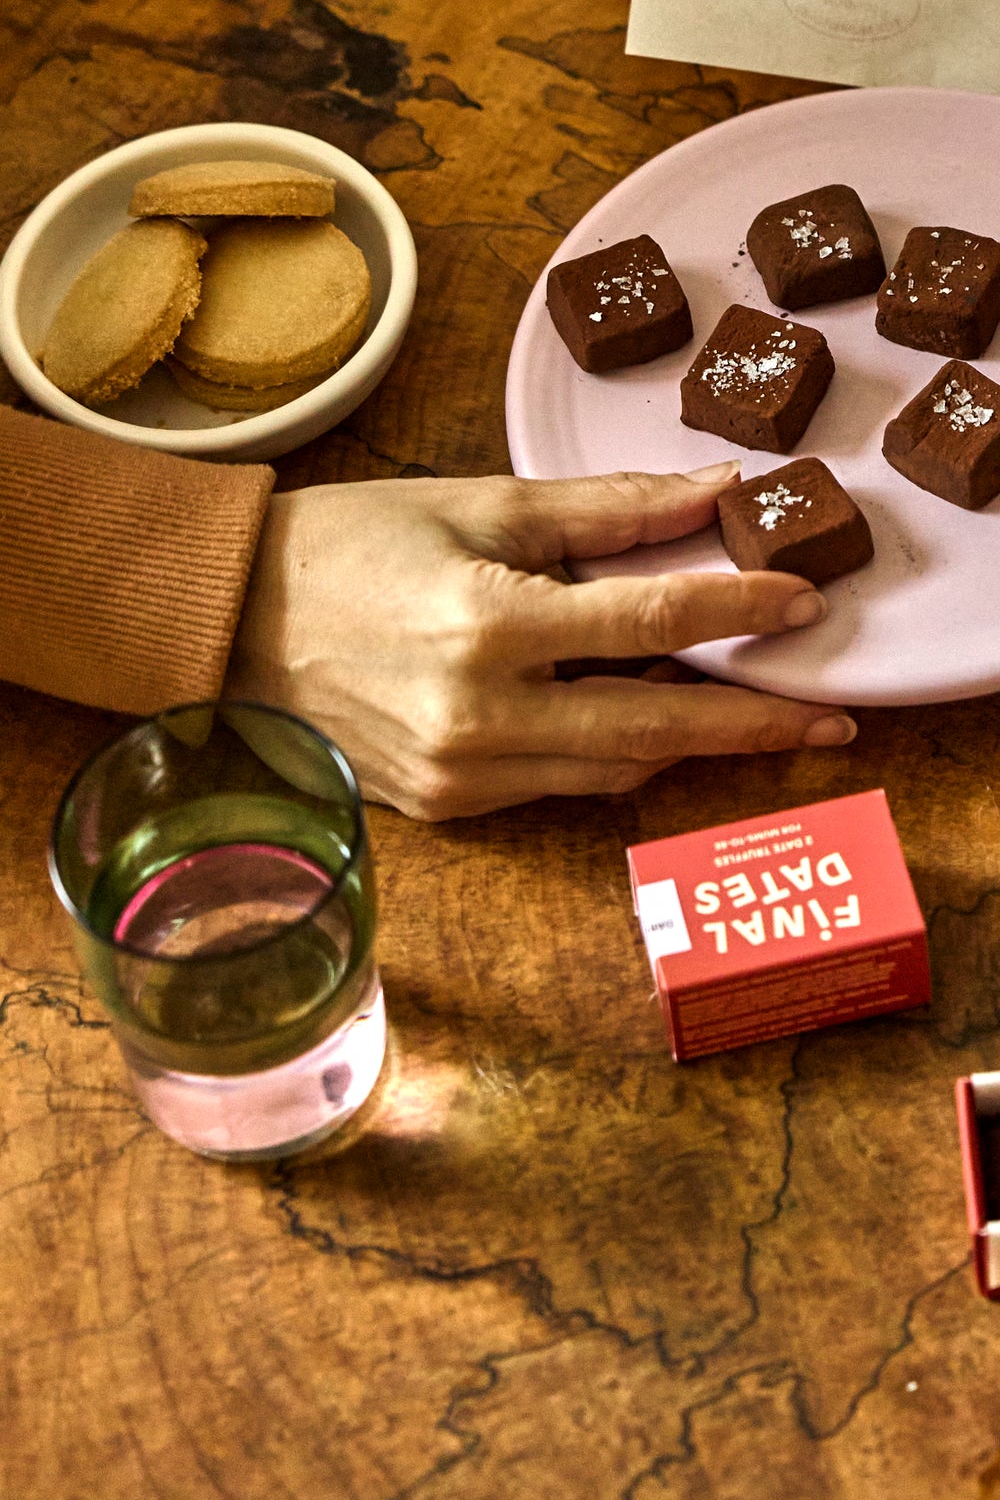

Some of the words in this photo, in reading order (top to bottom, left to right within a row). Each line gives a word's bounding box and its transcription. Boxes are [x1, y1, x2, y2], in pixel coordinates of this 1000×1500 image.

[713, 845, 771, 868] TRUFFLES
[773, 837, 803, 854] DATE
[693, 852, 852, 915] DATES
